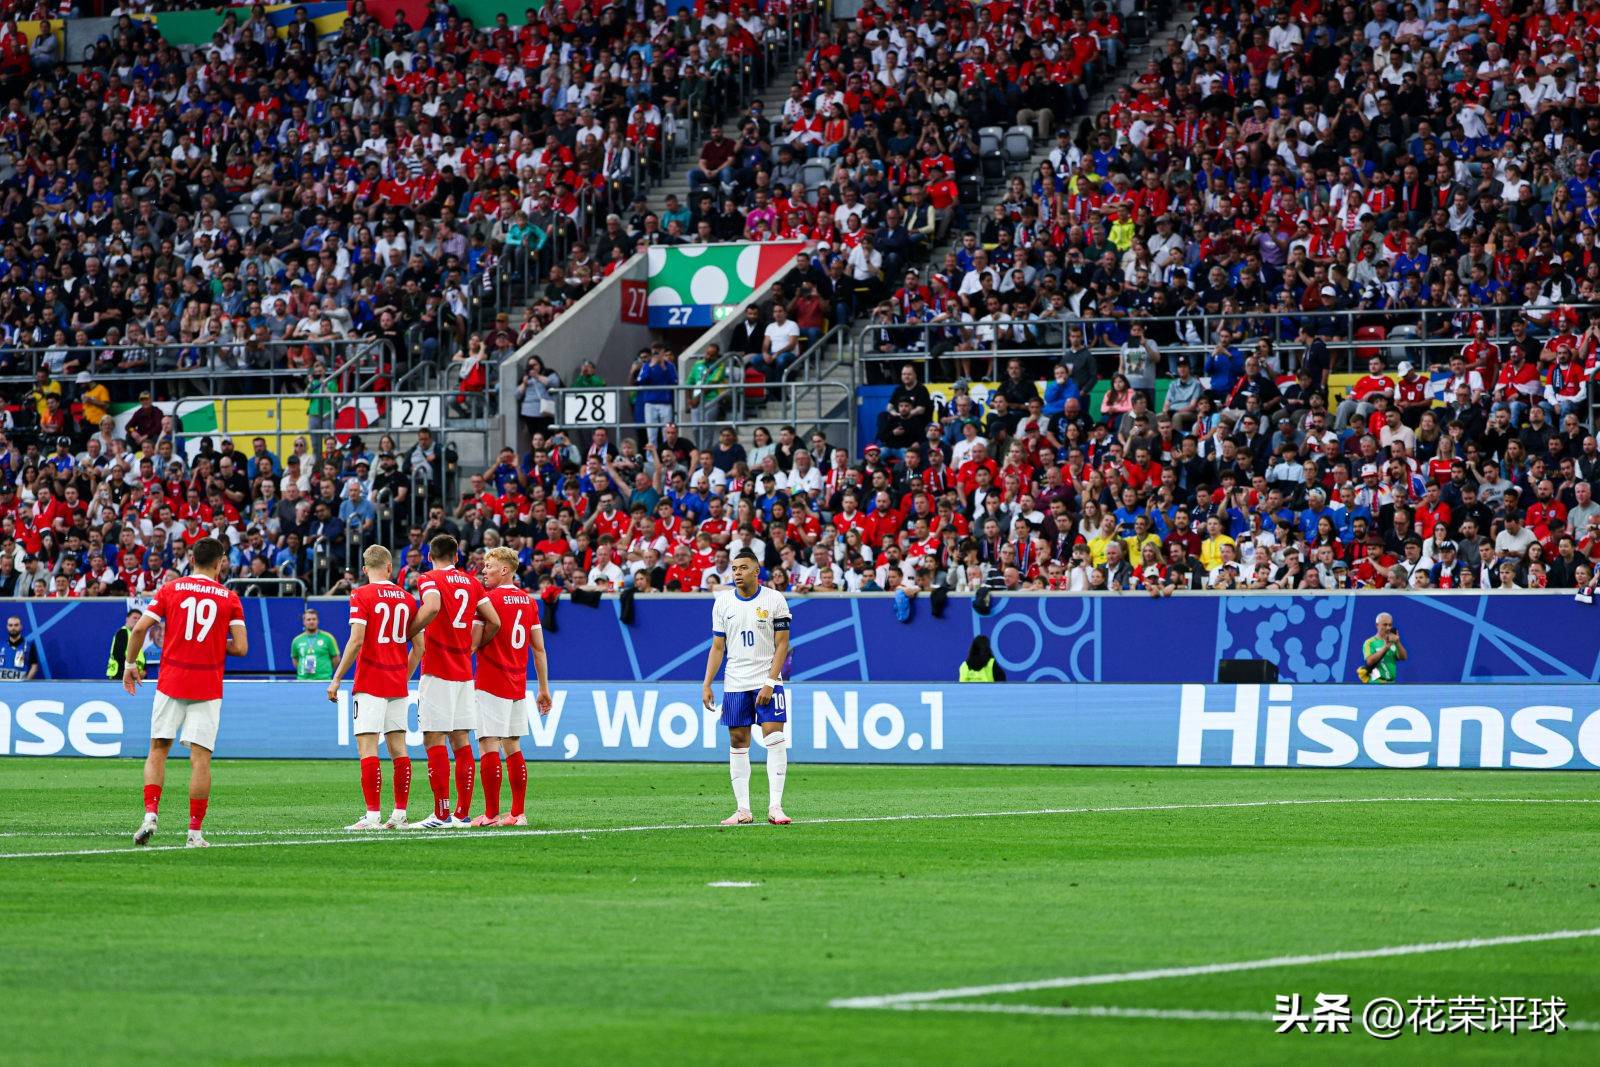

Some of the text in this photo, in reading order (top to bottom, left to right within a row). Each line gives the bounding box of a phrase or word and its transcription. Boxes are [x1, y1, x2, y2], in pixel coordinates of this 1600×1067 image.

[628, 287, 647, 317] 27
[668, 307, 692, 325] 27
[401, 399, 430, 427] 27
[574, 394, 606, 423] 28
[175, 582, 229, 598] BAUMGARTNER
[377, 588, 406, 599] LAIMER
[503, 595, 530, 605] SEIWALD
[180, 596, 218, 643] 19
[452, 588, 469, 629] 2
[374, 602, 410, 644] 20
[511, 609, 526, 650] 6
[740, 630, 754, 647] 10
[0, 669, 21, 680] ECH
[772, 693, 785, 710] 10
[813, 691, 944, 750] No.1
